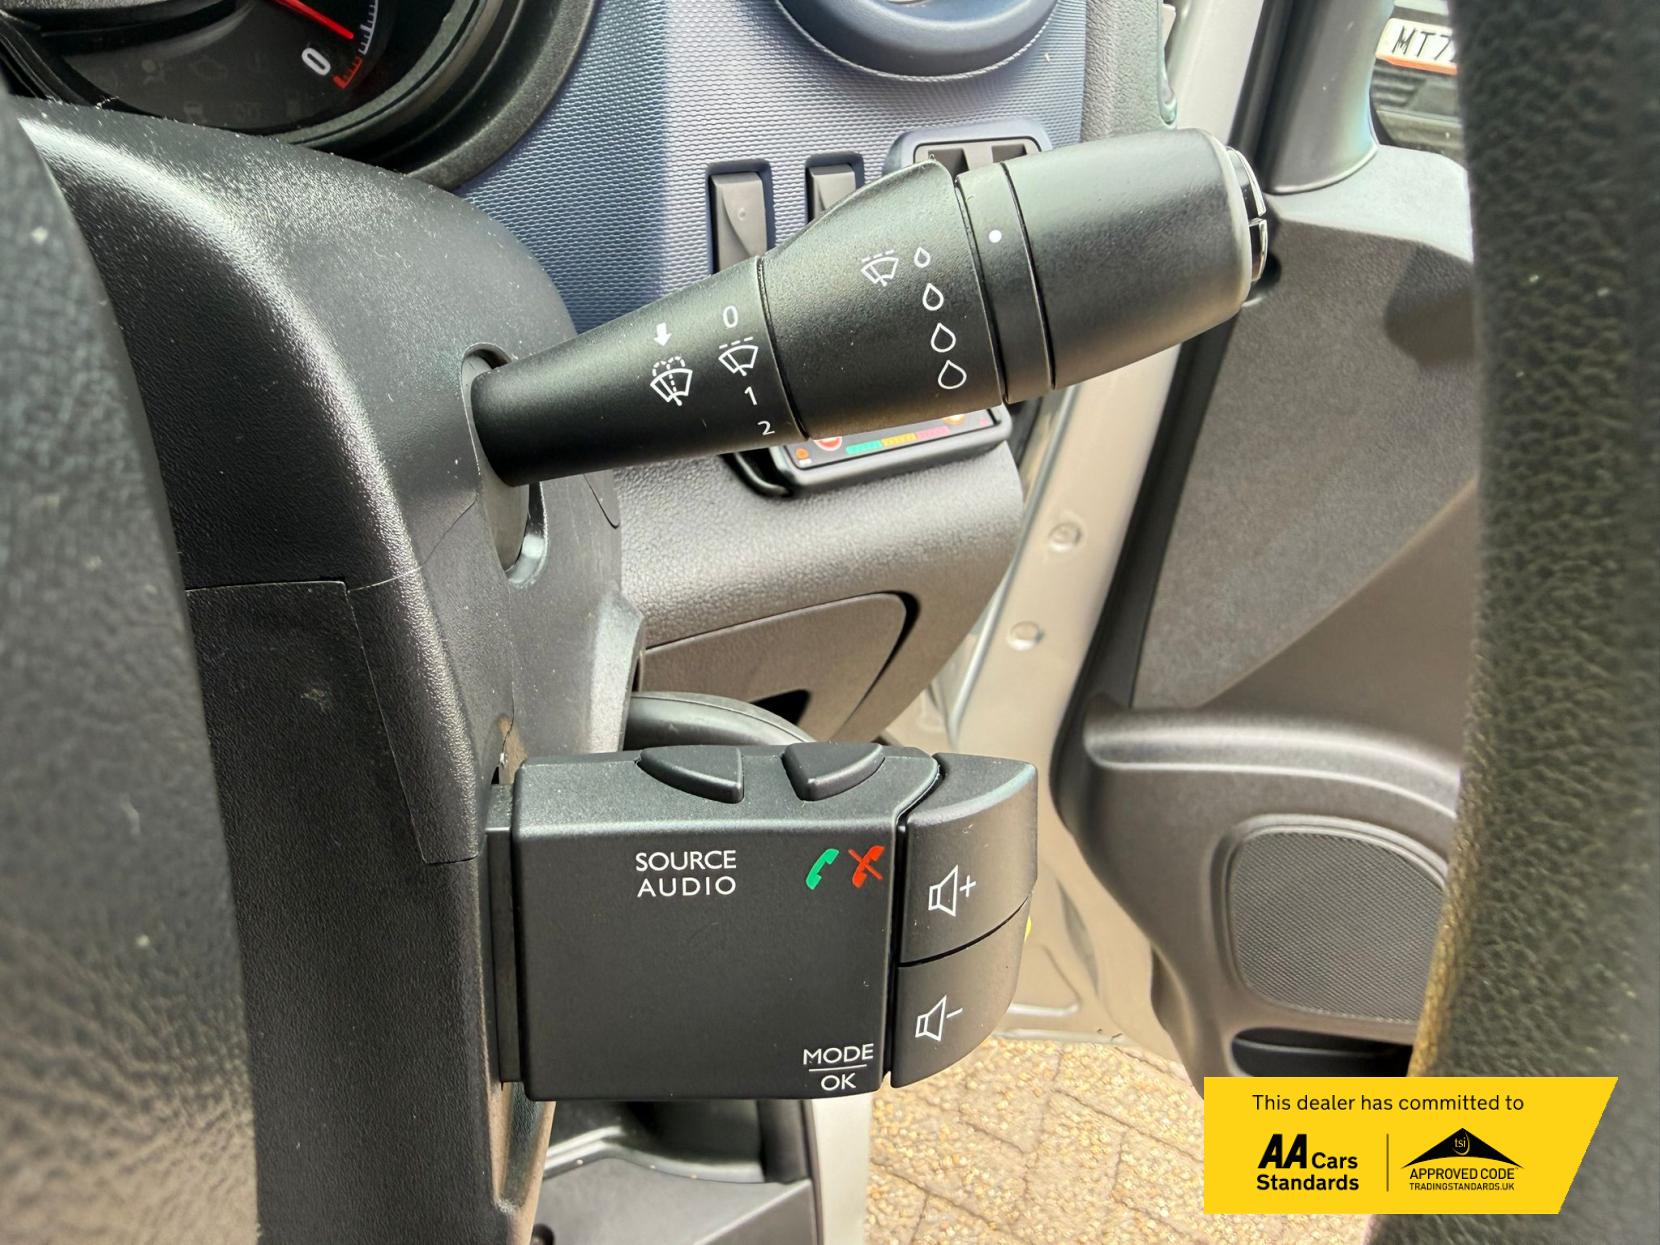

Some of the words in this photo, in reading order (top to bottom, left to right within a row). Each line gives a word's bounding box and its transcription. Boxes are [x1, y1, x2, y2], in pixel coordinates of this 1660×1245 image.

[301, 47, 331, 76] 0
[723, 305, 739, 329] 0
[744, 386, 758, 406] 1
[757, 420, 776, 436] 2
[635, 849, 737, 873] SOURCE
[636, 875, 737, 898] AUDIO
[802, 1043, 875, 1066] MODE
[820, 1072, 857, 1092] OK
